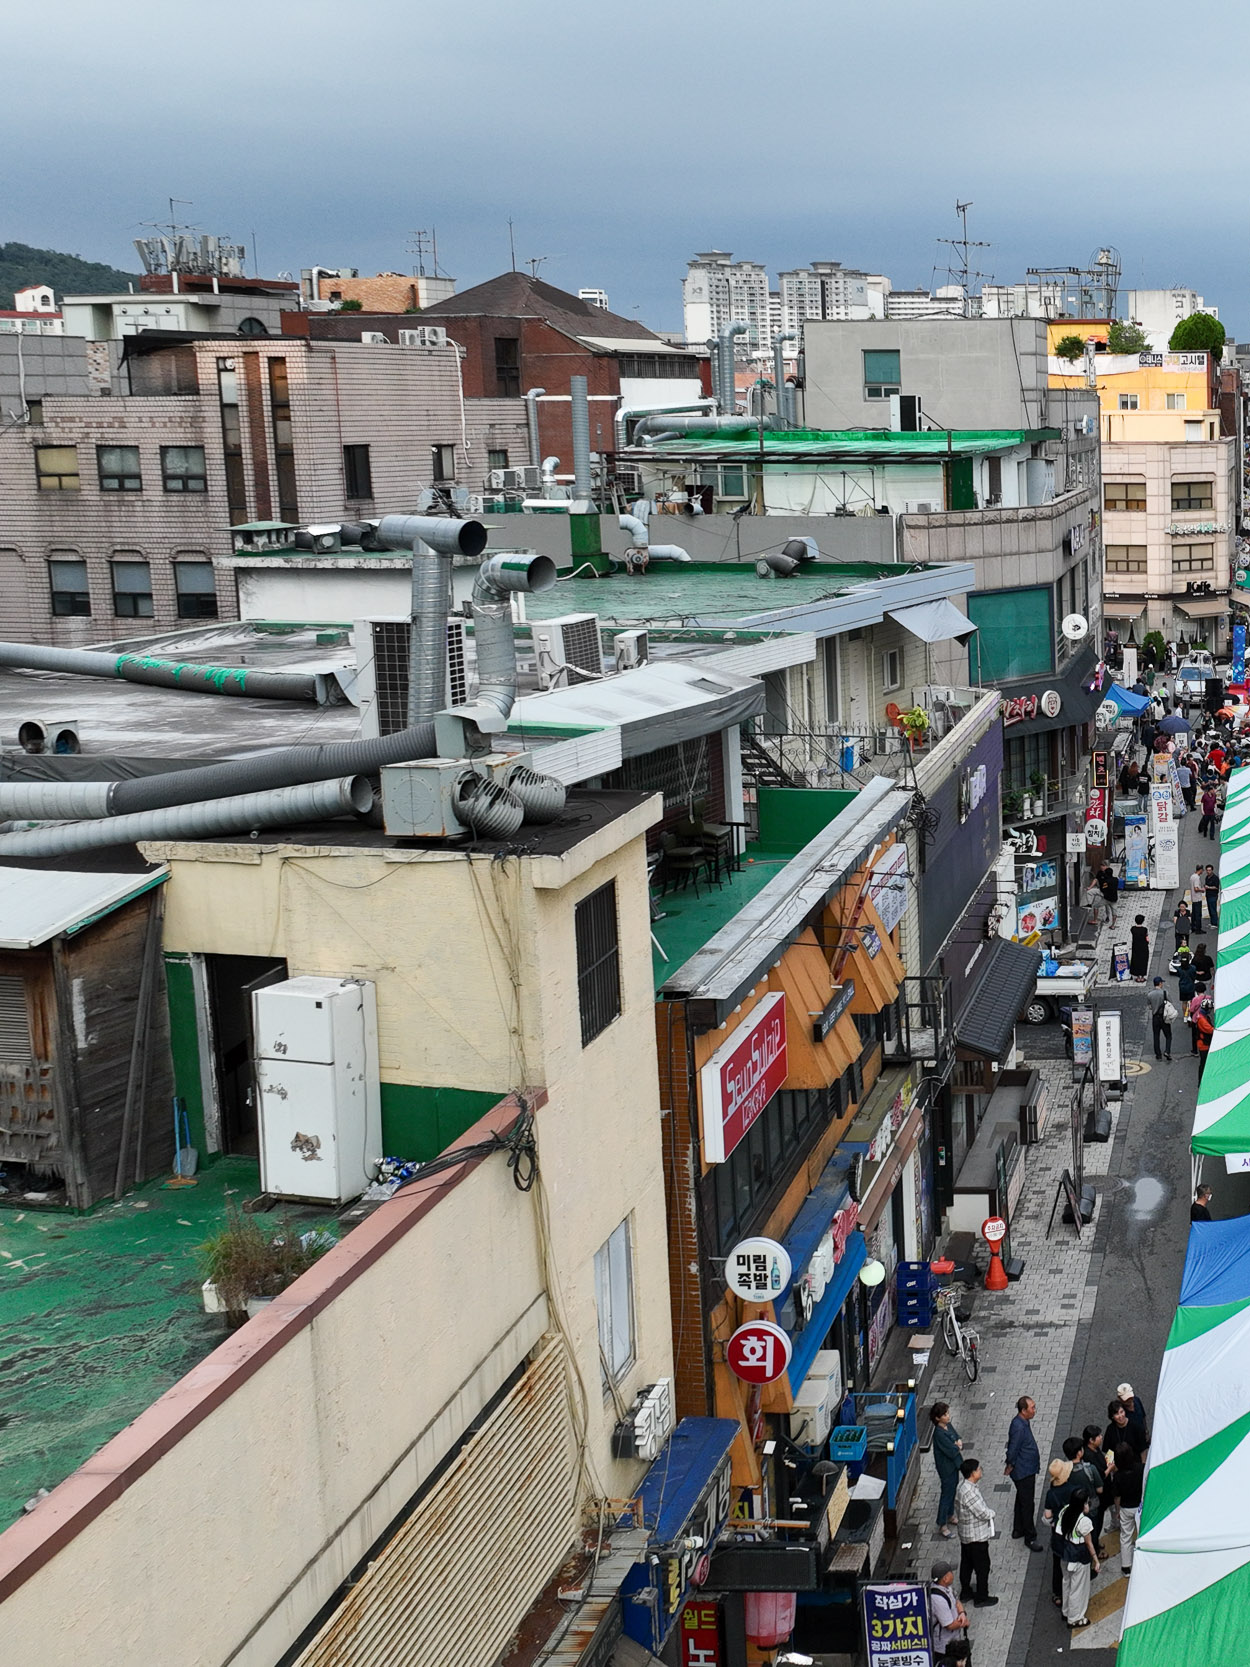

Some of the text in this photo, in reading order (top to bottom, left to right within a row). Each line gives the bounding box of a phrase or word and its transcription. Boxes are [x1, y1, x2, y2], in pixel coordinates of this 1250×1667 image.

[986, 1222, 1004, 1231] 주차금지
[736, 1254, 767, 1272] 미림
[737, 1272, 769, 1290] 족발
[738, 1336, 775, 1378] 회
[874, 1591, 918, 1610] 작심가
[683, 1608, 717, 1630] 월드
[871, 1616, 924, 1639] 3가지
[871, 1638, 928, 1652] 공짜서비스!!
[877, 1655, 924, 1667] 눈꽃빙수
